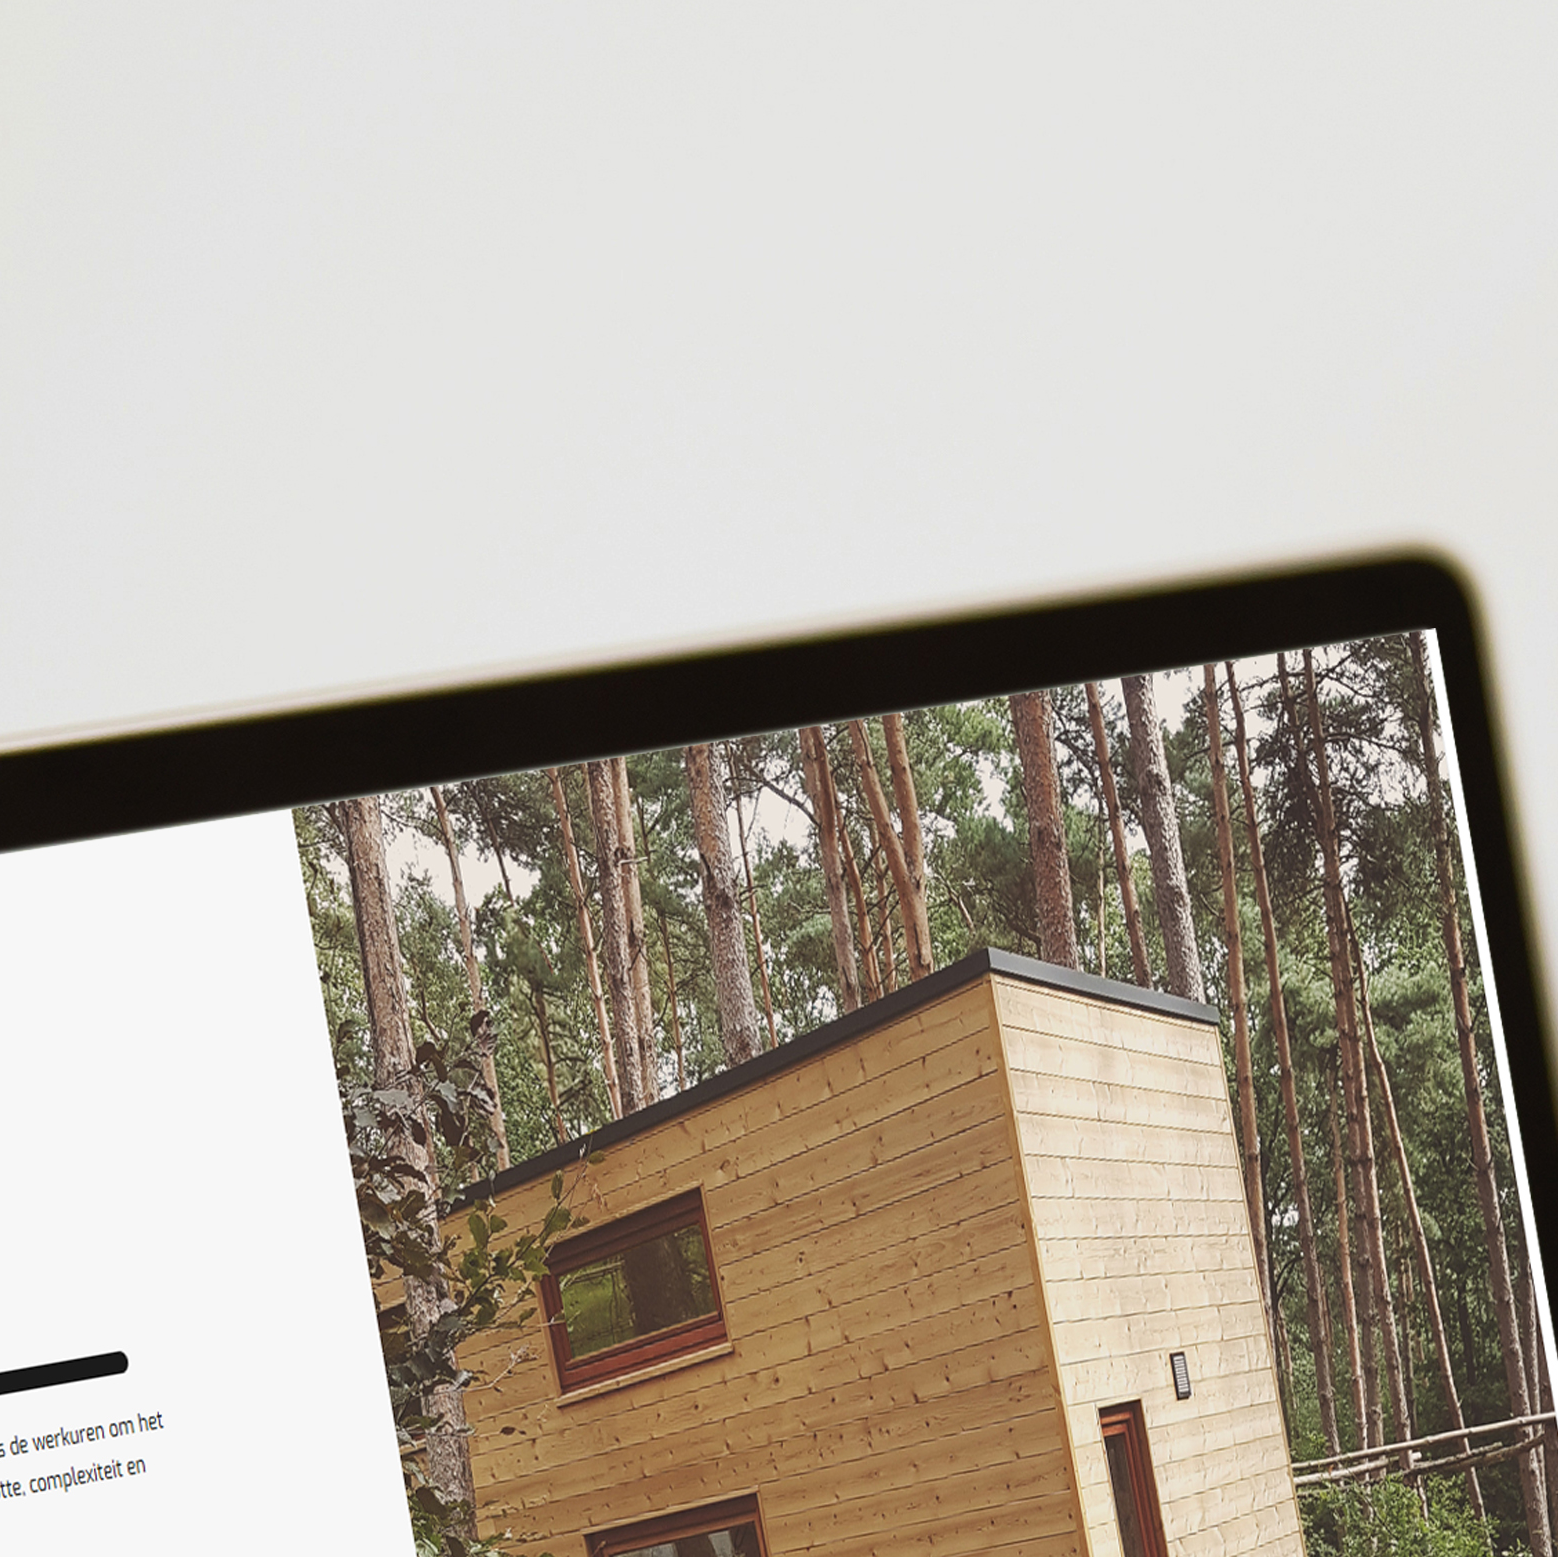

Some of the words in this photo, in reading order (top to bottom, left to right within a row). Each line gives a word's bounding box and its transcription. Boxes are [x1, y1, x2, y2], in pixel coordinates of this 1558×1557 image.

[9, 1434, 30, 1456] de
[31, 1424, 106, 1451] werkuren
[108, 1419, 136, 1438] om
[136, 1411, 165, 1433] het
